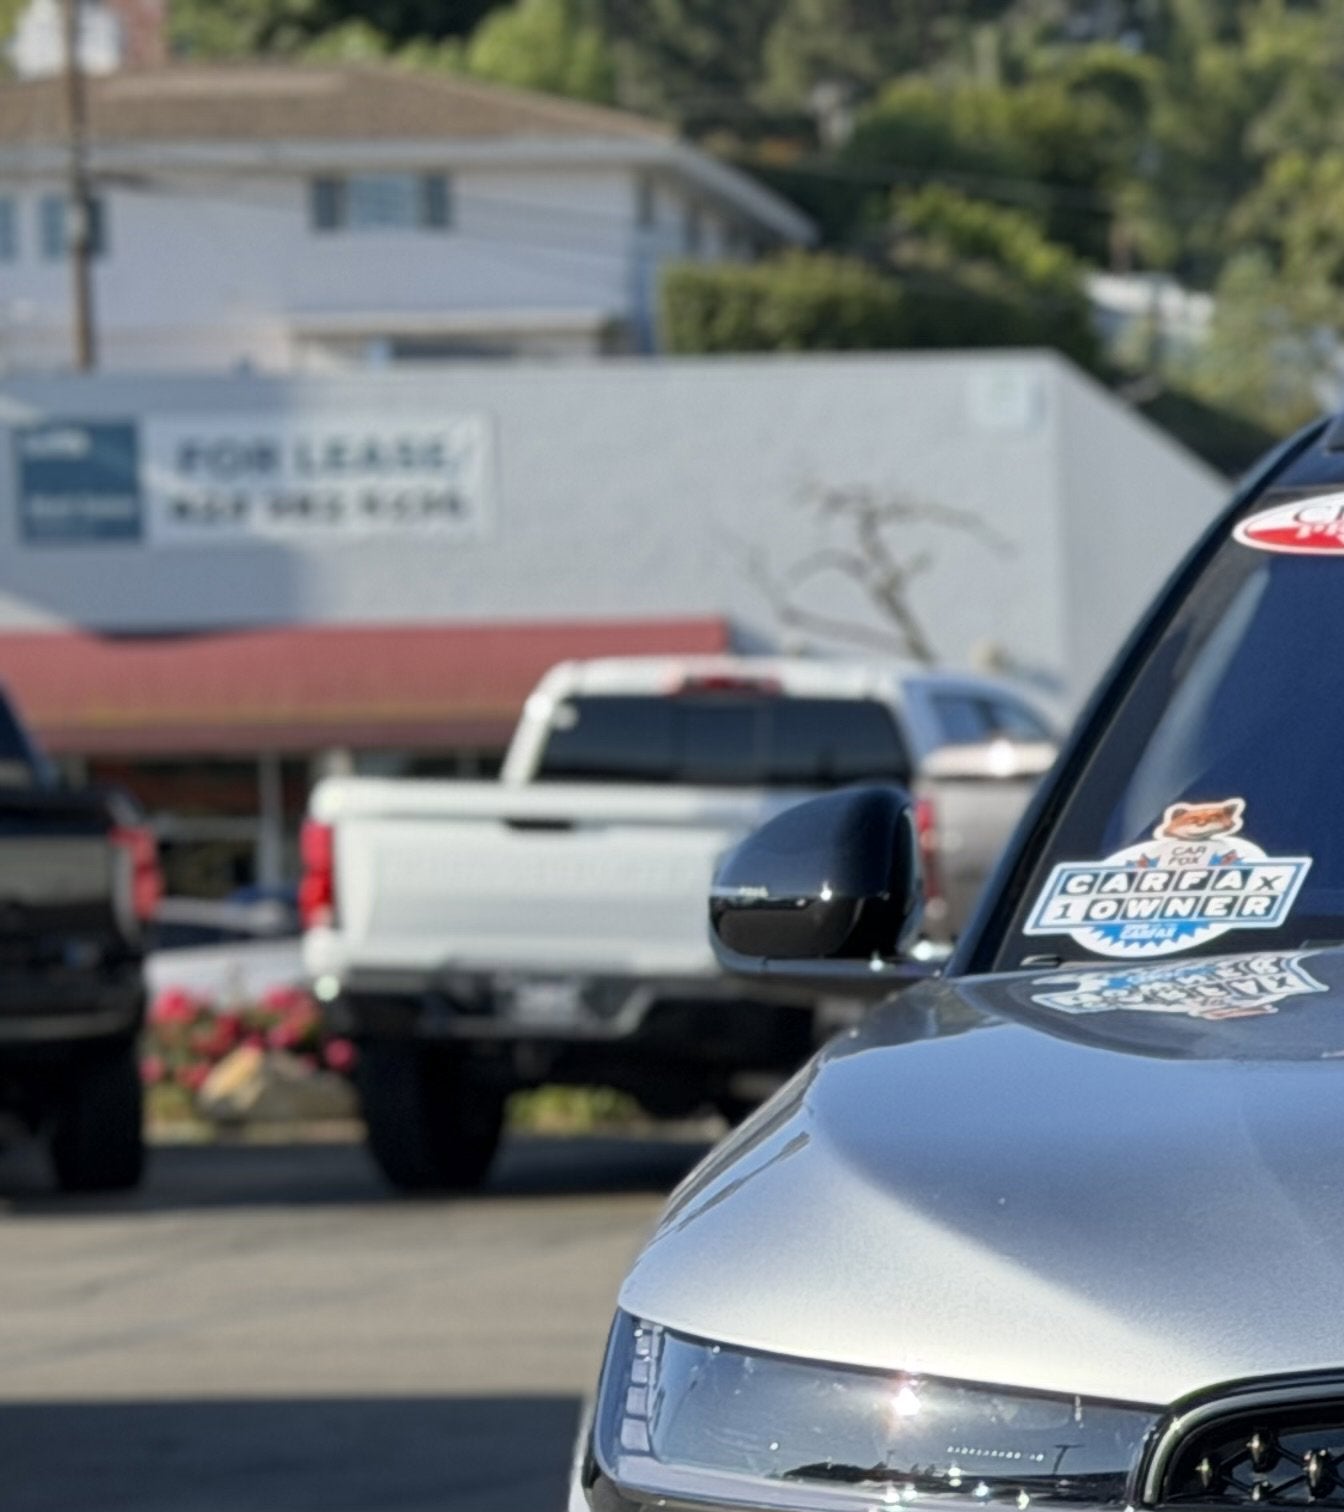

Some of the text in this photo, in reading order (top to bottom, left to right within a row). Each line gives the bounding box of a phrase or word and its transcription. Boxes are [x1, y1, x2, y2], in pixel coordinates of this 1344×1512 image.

[178, 434, 281, 477] FOR
[1167, 855, 1203, 867] FOX
[1171, 845, 1208, 857] CAR
[1066, 869, 1282, 895] CARFAX
[1089, 896, 1273, 920] OWNER
